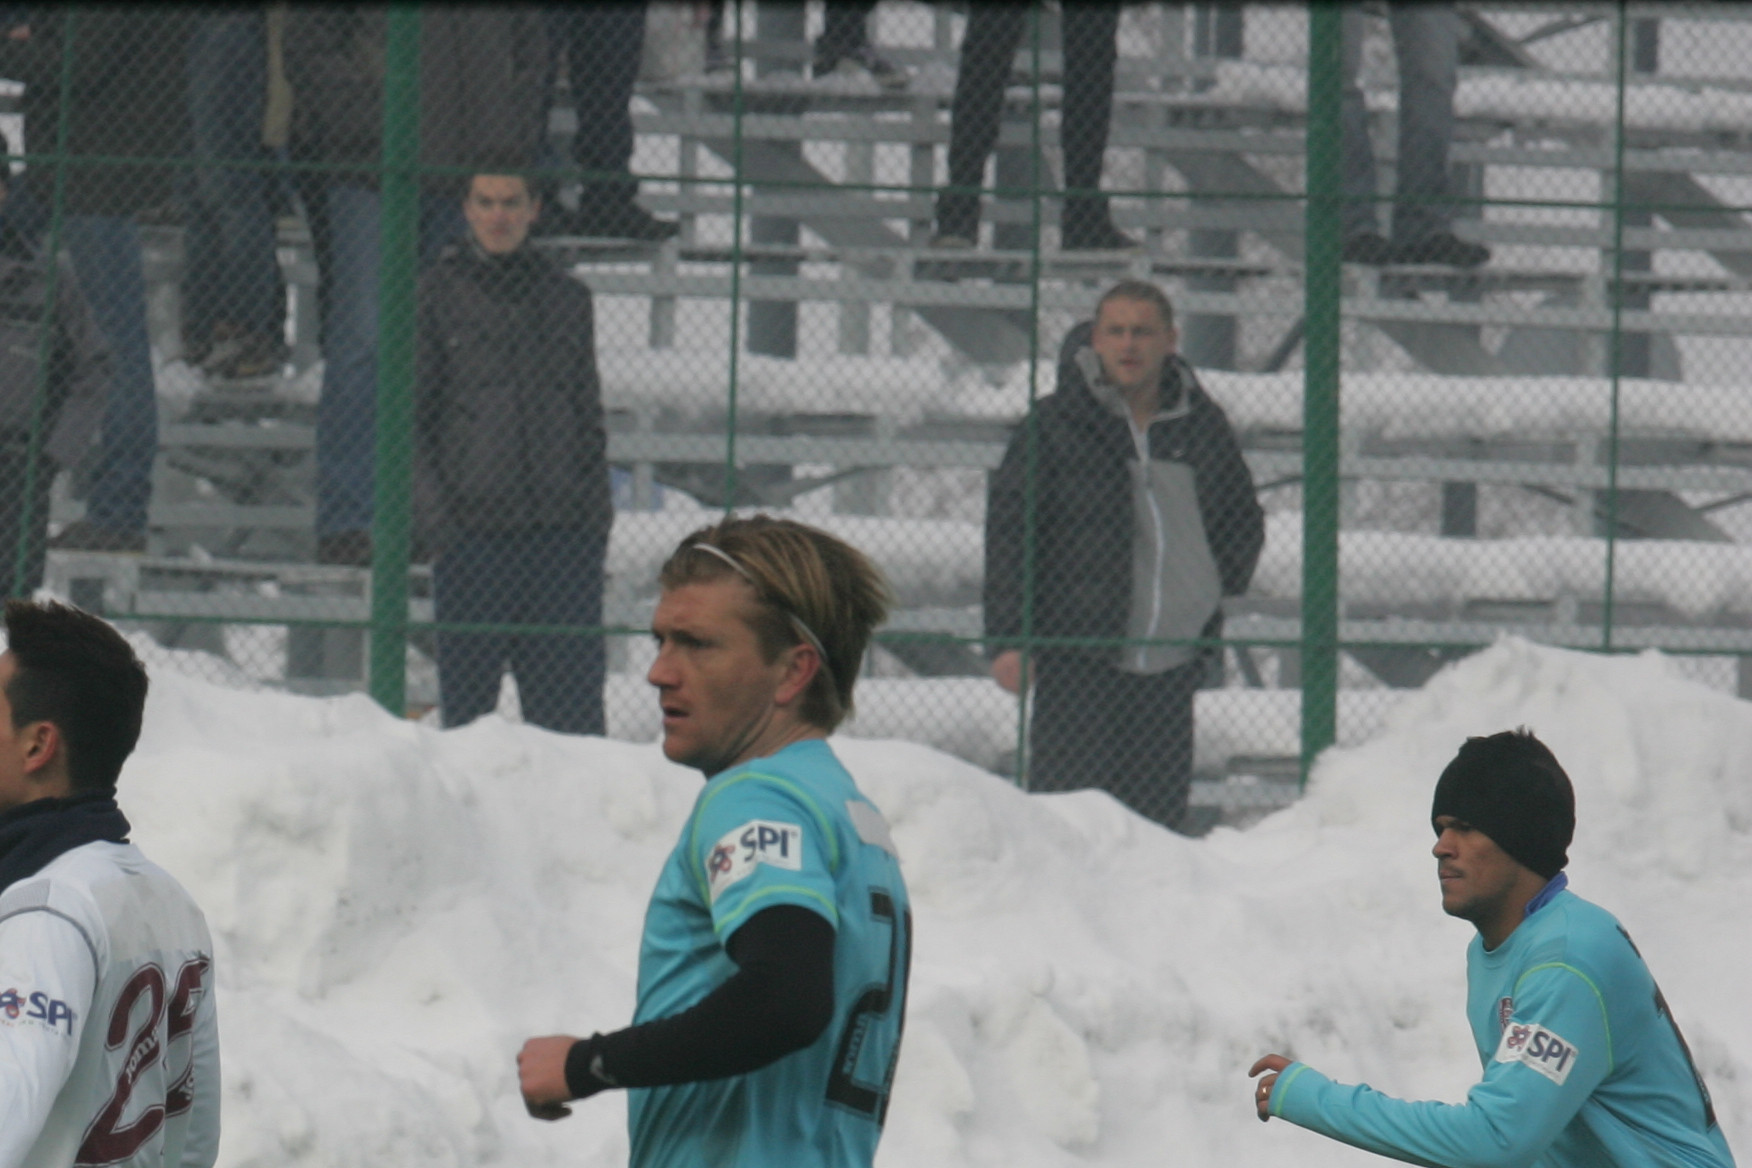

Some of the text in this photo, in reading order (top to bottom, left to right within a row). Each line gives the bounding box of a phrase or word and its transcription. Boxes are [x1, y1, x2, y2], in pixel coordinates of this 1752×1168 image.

[739, 825, 790, 862] SPI
[25, 991, 73, 1037] SPI
[823, 885, 912, 1128] 2
[1527, 1030, 1572, 1073] SPI
